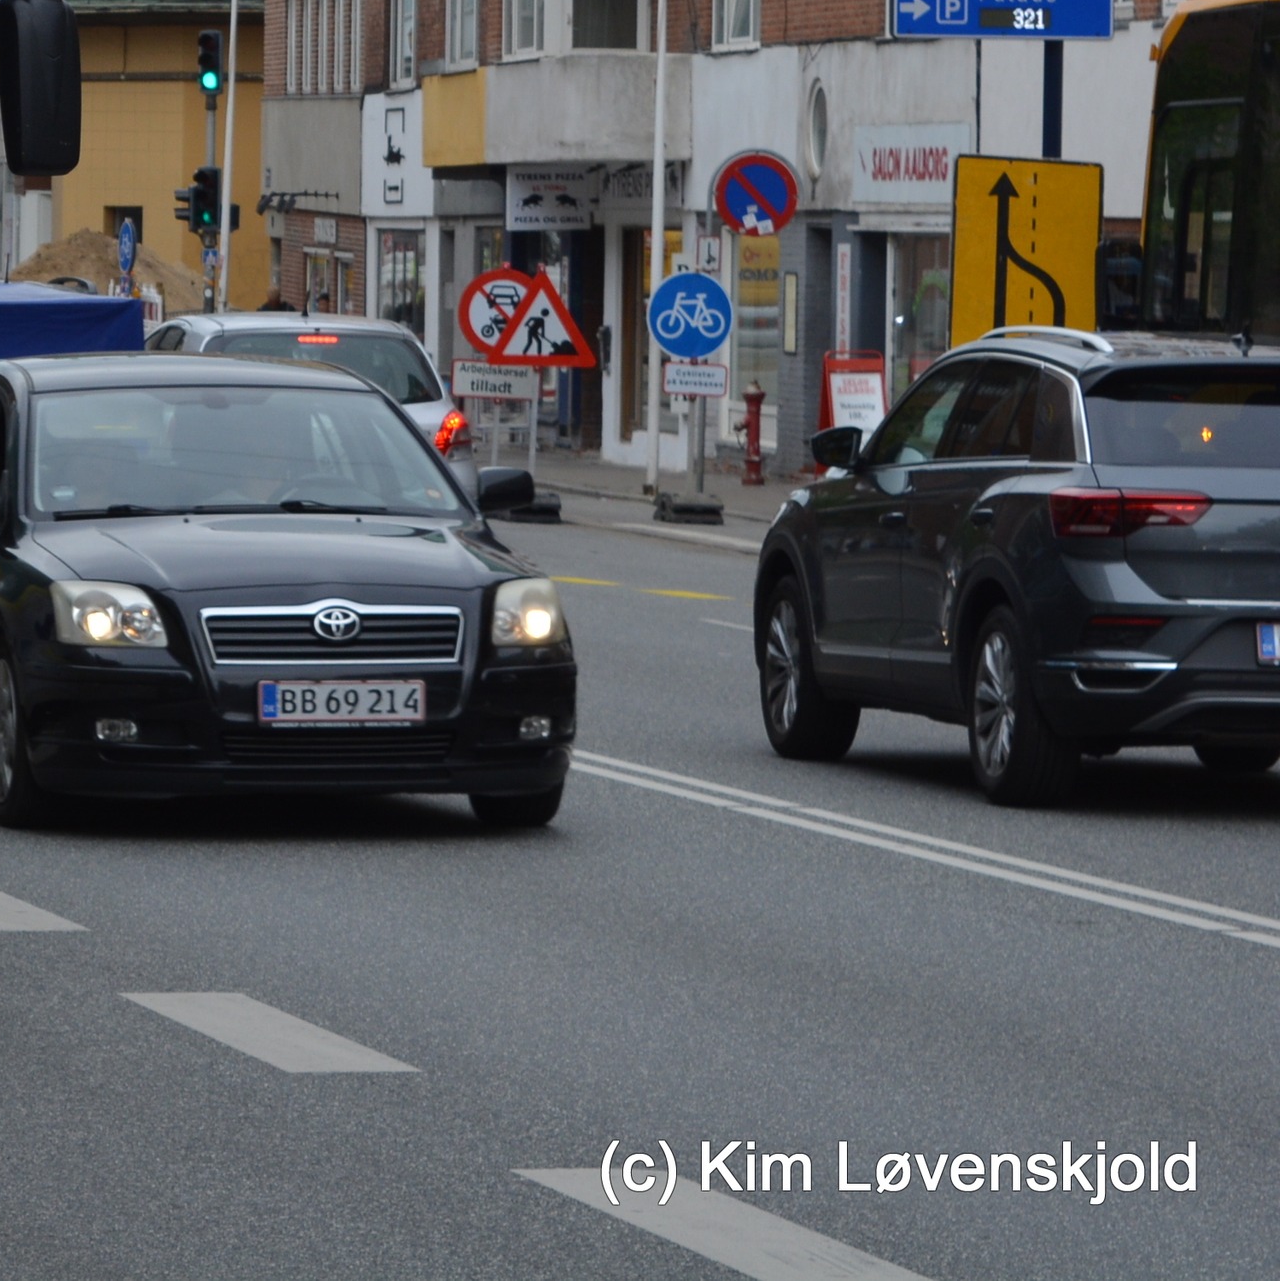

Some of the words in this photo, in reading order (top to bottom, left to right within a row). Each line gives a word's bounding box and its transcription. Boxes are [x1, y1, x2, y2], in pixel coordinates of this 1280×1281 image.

[1012, 7, 1045, 30] 321
[871, 147, 901, 181] SALON
[902, 147, 948, 181] AALBORG
[554, 173, 584, 181] PIZZA
[514, 216, 540, 224] PIZZA
[543, 216, 558, 224] OG
[560, 216, 585, 224] GRILL
[459, 363, 528, 377] Arbejdskørsel
[470, 380, 512, 394] tilladt
[281, 689, 317, 714] BB
[325, 688, 359, 715] 69
[367, 688, 419, 714] 214
